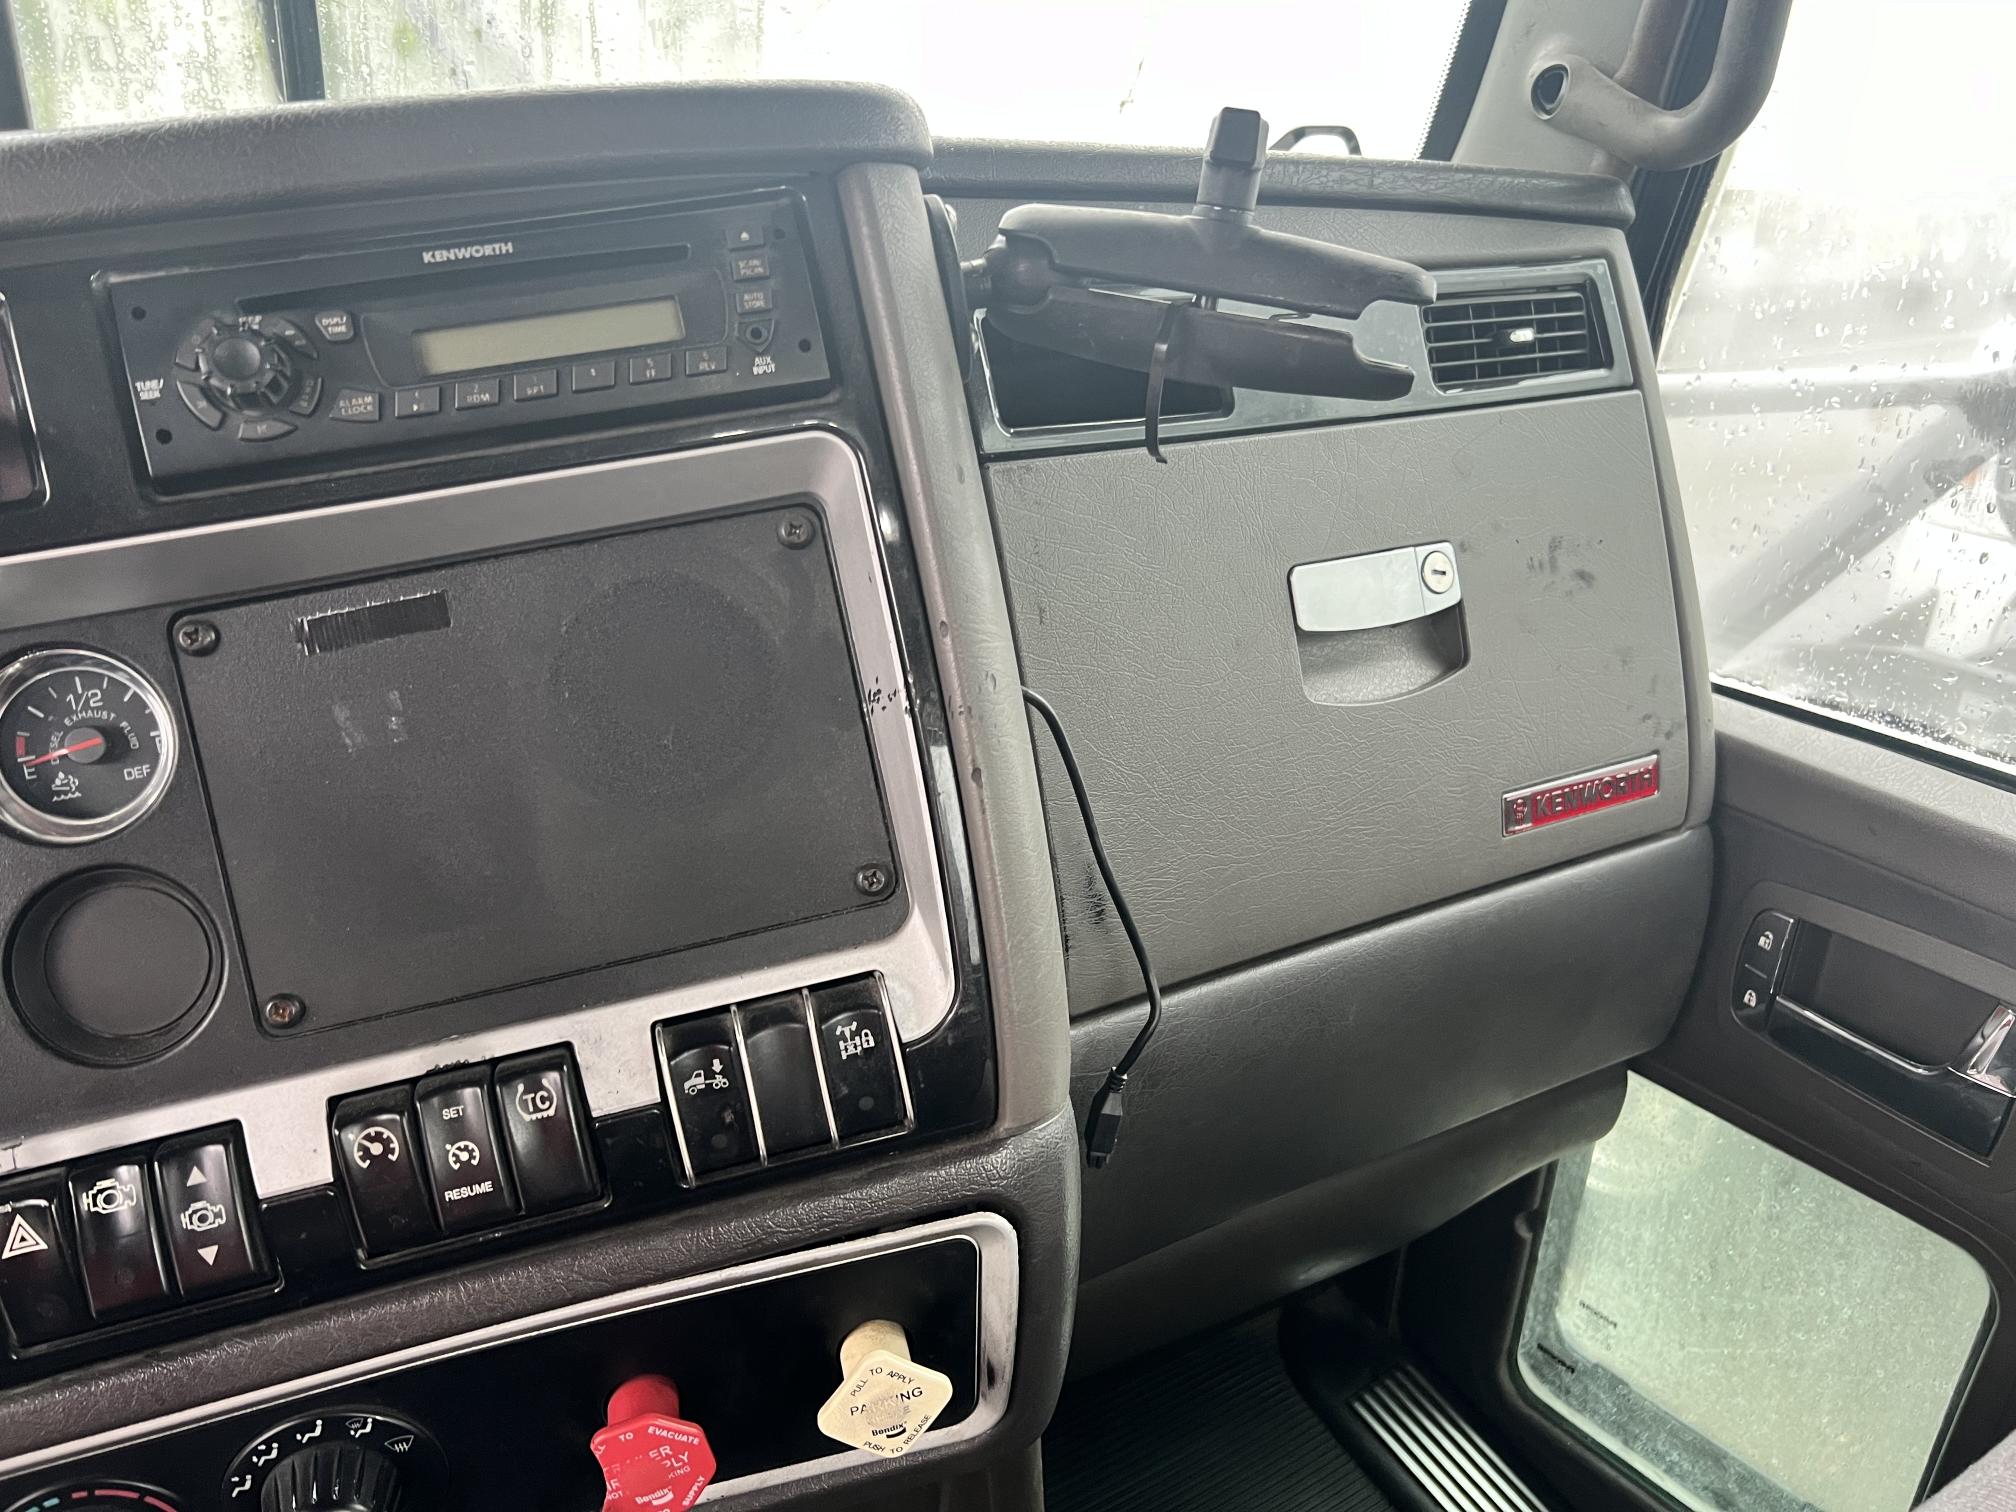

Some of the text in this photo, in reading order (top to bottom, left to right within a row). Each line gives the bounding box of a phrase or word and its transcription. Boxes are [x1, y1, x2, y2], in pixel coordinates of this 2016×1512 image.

[422, 242, 513, 264] KENWORTH
[328, 324, 347, 335] TIME
[753, 363, 775, 376] INPUT
[754, 356, 772, 367] AUX
[66, 689, 104, 711] 1/2
[63, 709, 117, 727] EXHAUST
[119, 721, 139, 749] FLUID
[123, 764, 151, 781] DEF
[1535, 766, 1655, 817] KENWORTH
[522, 1091, 551, 1112] TC
[442, 1105, 464, 1120] SET
[444, 1181, 494, 1202] RESUME
[850, 1366, 915, 1397] PULL TO APPLY
[863, 1414, 931, 1454] PUSH TO RELEASE
[618, 1425, 705, 1506] TO EVACUATE SUPPLY
